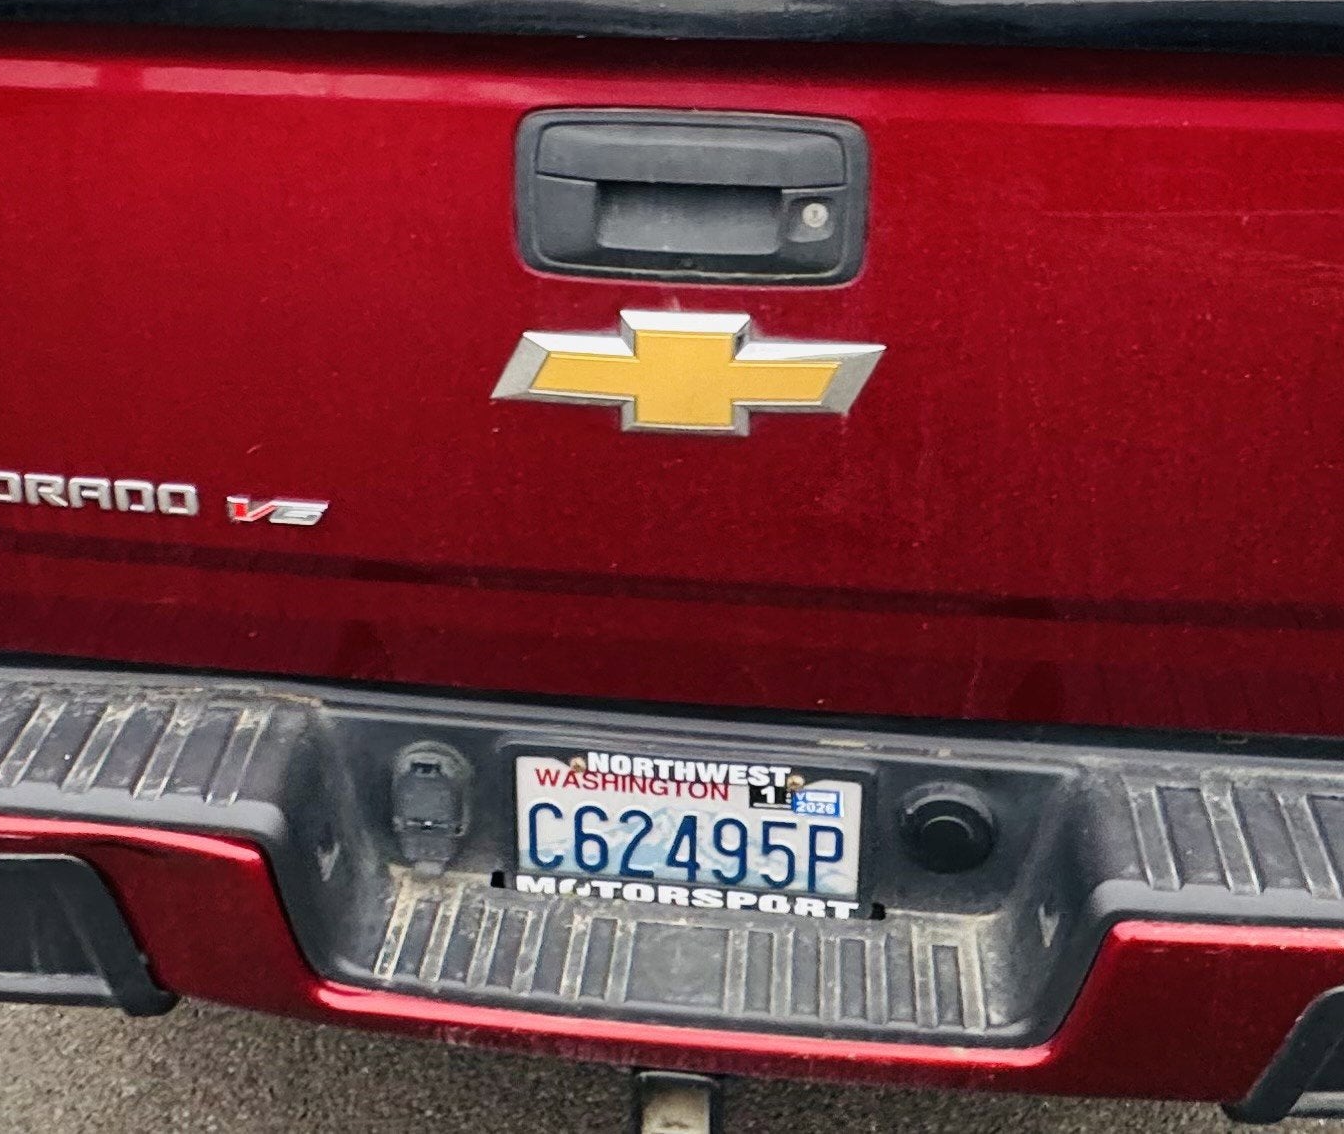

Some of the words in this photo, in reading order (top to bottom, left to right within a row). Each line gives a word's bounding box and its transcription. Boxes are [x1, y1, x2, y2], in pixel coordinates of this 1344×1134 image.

[225, 495, 330, 526] V6
[534, 767, 730, 802] WASHINGTON
[586, 751, 792, 788] NORTHWEST
[795, 801, 836, 815] 2026
[527, 801, 845, 895] C62495P
[516, 874, 860, 920] MOTORSPORT
